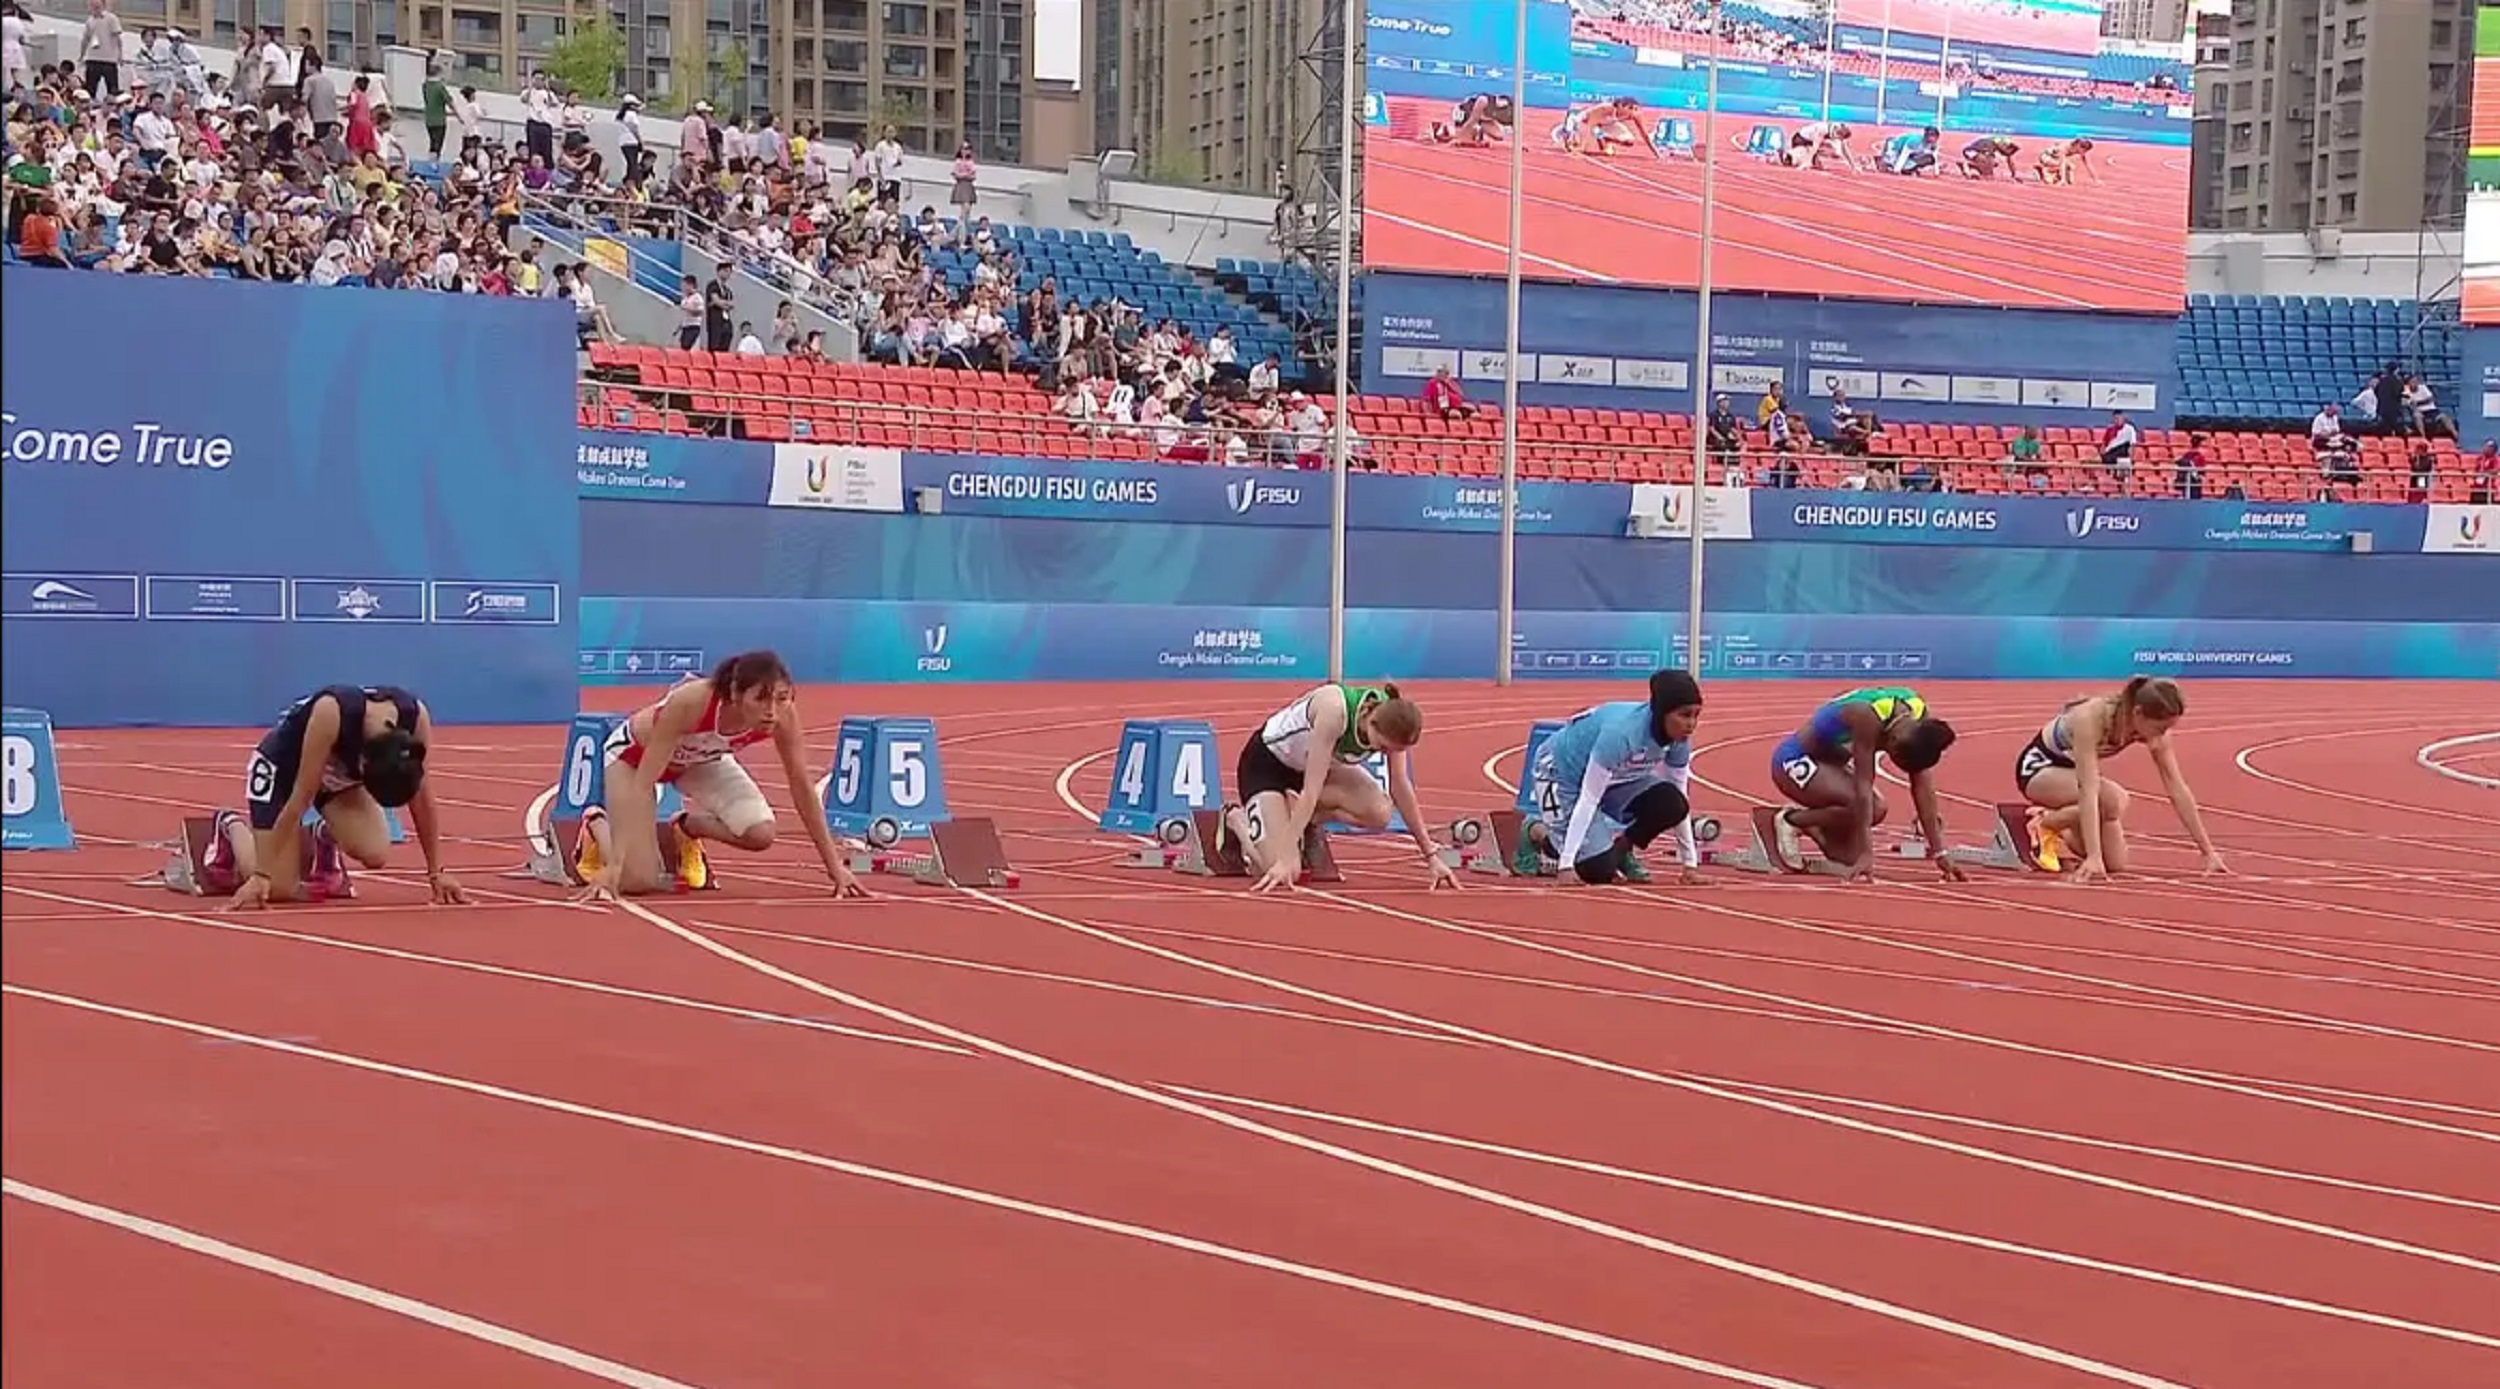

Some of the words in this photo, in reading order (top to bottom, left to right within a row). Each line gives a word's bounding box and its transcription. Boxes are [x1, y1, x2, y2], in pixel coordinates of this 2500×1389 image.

[1366, 11, 1411, 31] ome
[132, 424, 233, 469] True
[949, 473, 1041, 499] CHENGDU
[1046, 477, 1087, 500] FISU
[1092, 480, 1158, 503] GAMES
[1255, 486, 1300, 505] FISU
[1793, 505, 1883, 526] CHENGDU
[1887, 507, 1927, 527] FISU
[1932, 509, 1998, 530] GAMES
[2094, 515, 2139, 531] FISU
[917, 657, 951, 671] FISU
[2133, 650, 2156, 663] FISU
[2158, 650, 2195, 663] WORLD
[2195, 651, 2255, 664] UNIVERSITY
[2256, 652, 2293, 665] GAMES
[2, 735, 36, 815] 8
[567, 734, 597, 807] 6
[838, 738, 863, 805] 5
[888, 741, 926, 809] 5
[1119, 741, 1146, 806] 4
[1172, 743, 1206, 807] 4
[1541, 780, 1561, 818] 4
[1246, 801, 1263, 842] 5
